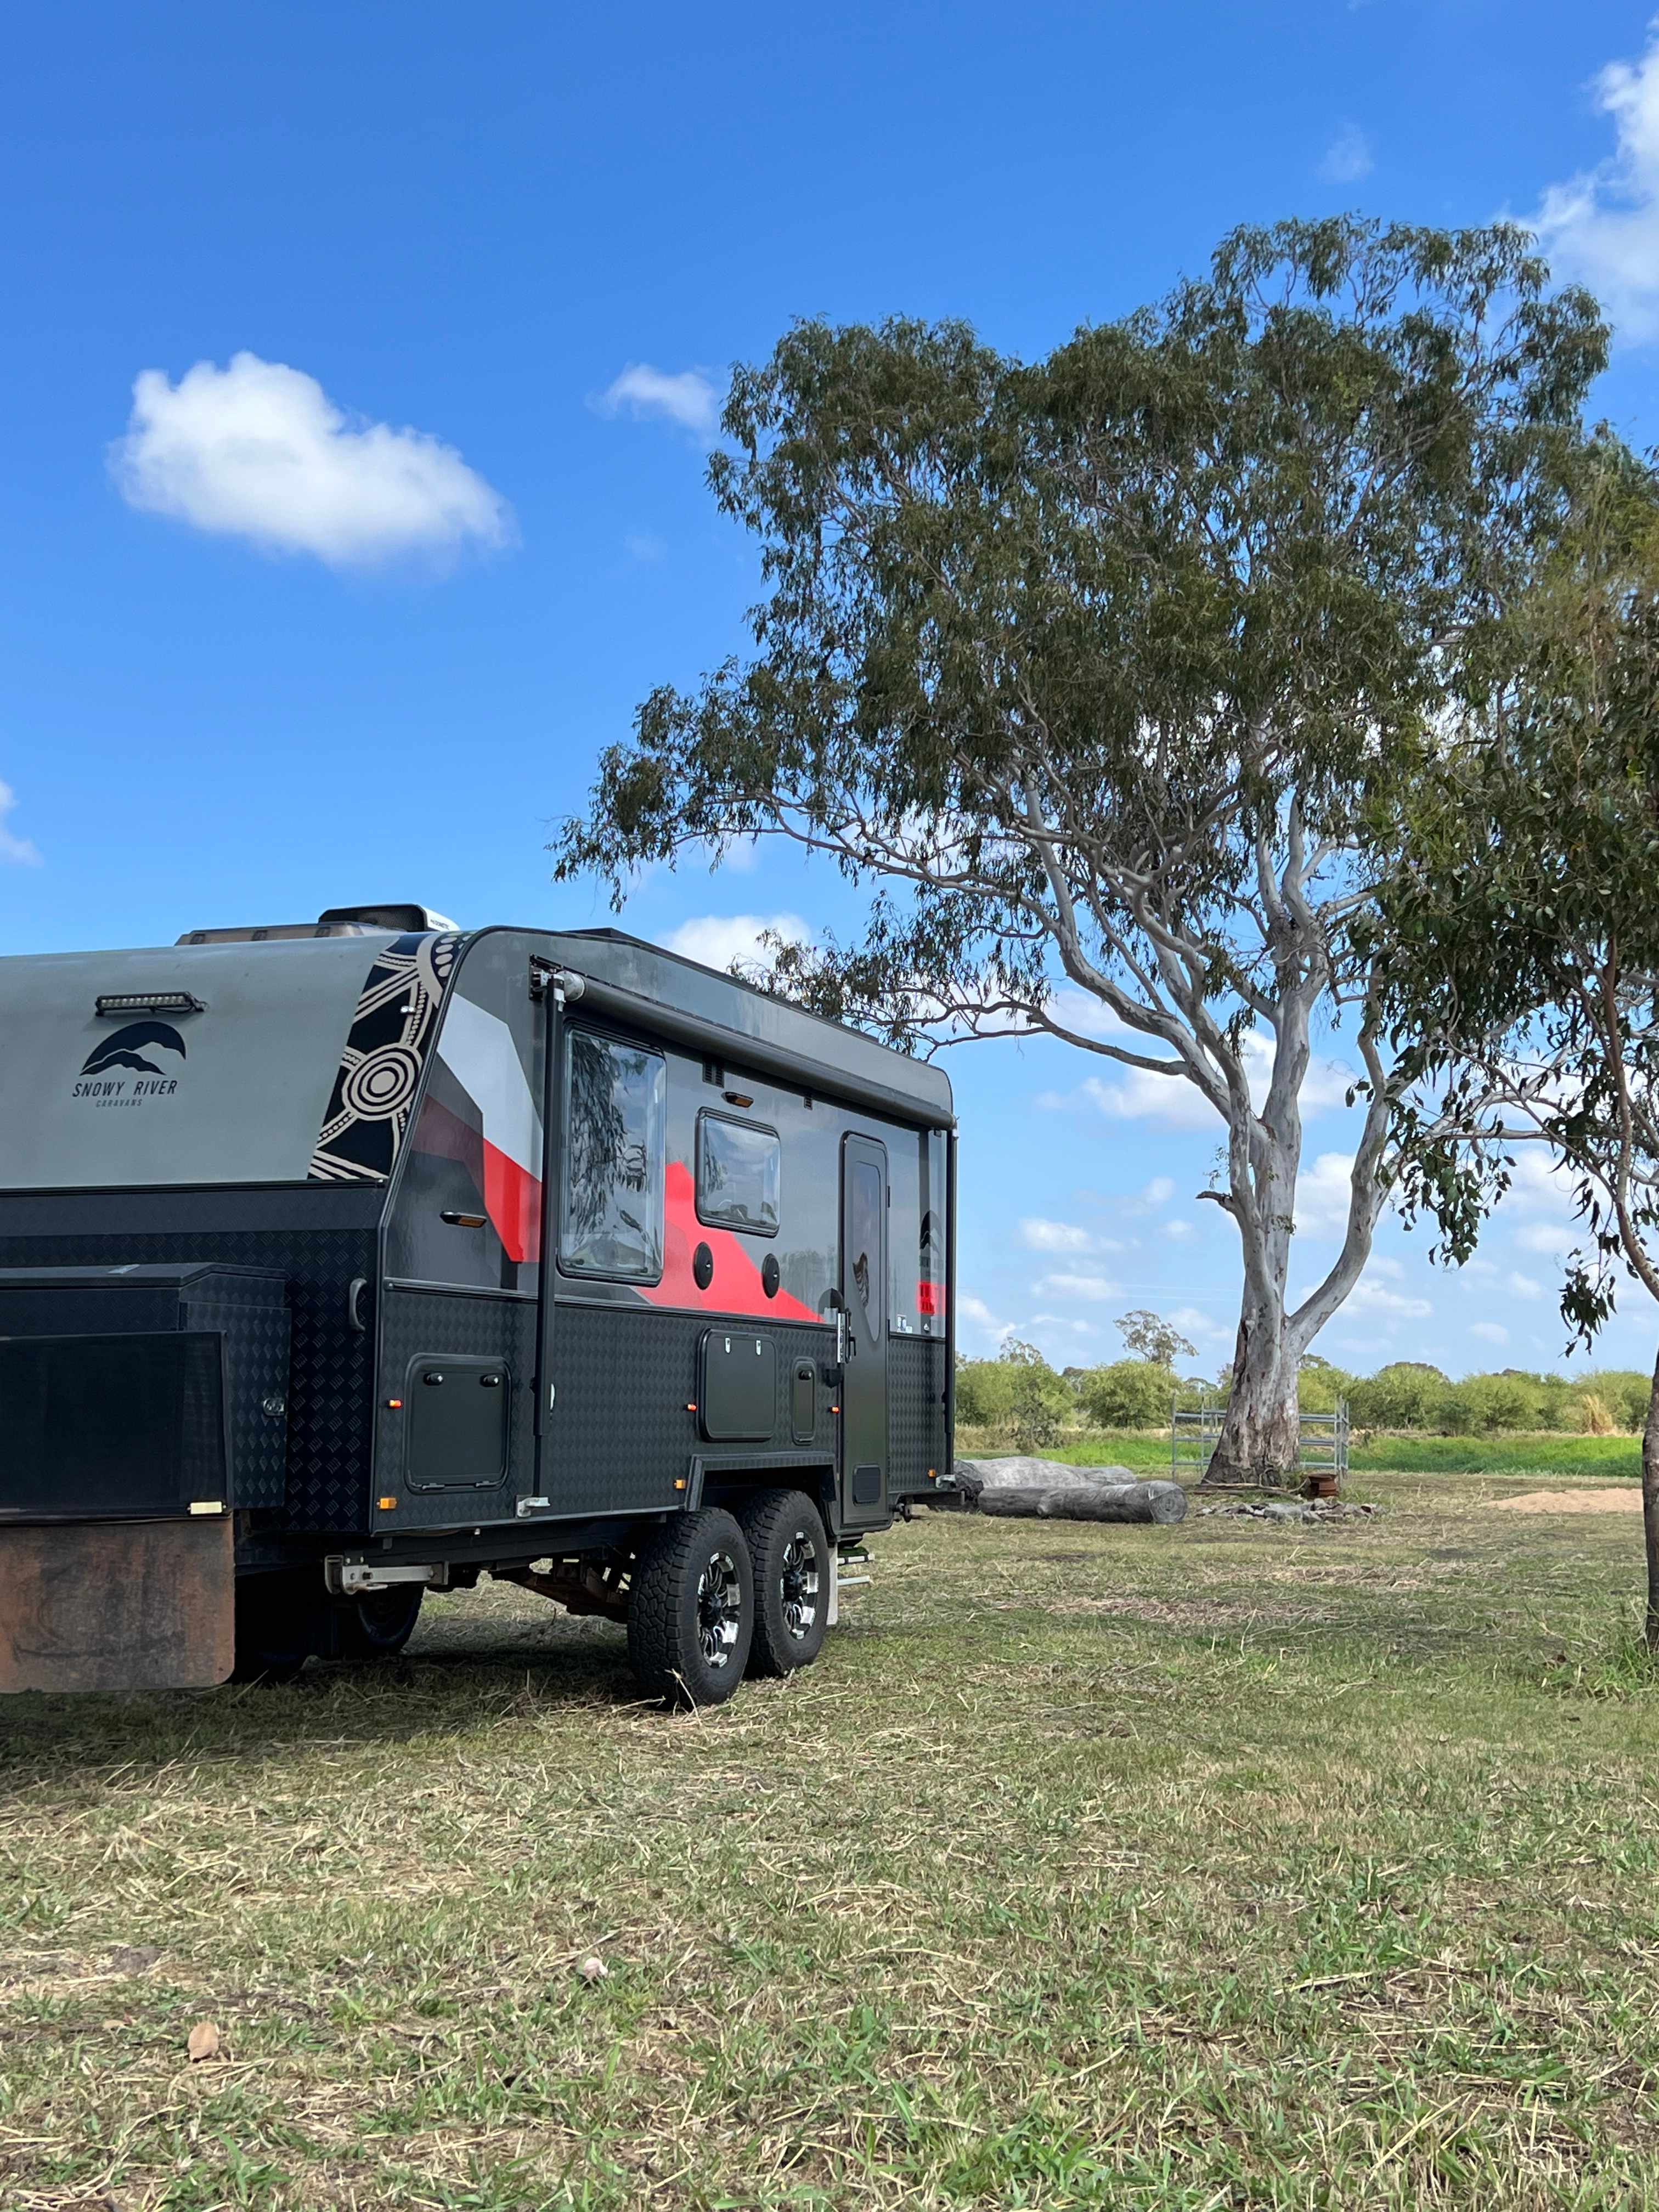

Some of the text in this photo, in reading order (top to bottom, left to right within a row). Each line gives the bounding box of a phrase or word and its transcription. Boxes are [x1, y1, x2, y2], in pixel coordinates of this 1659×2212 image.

[72, 1080, 178, 1097] SNOWY RIVER
[96, 1099, 143, 1107] CARAVANS
